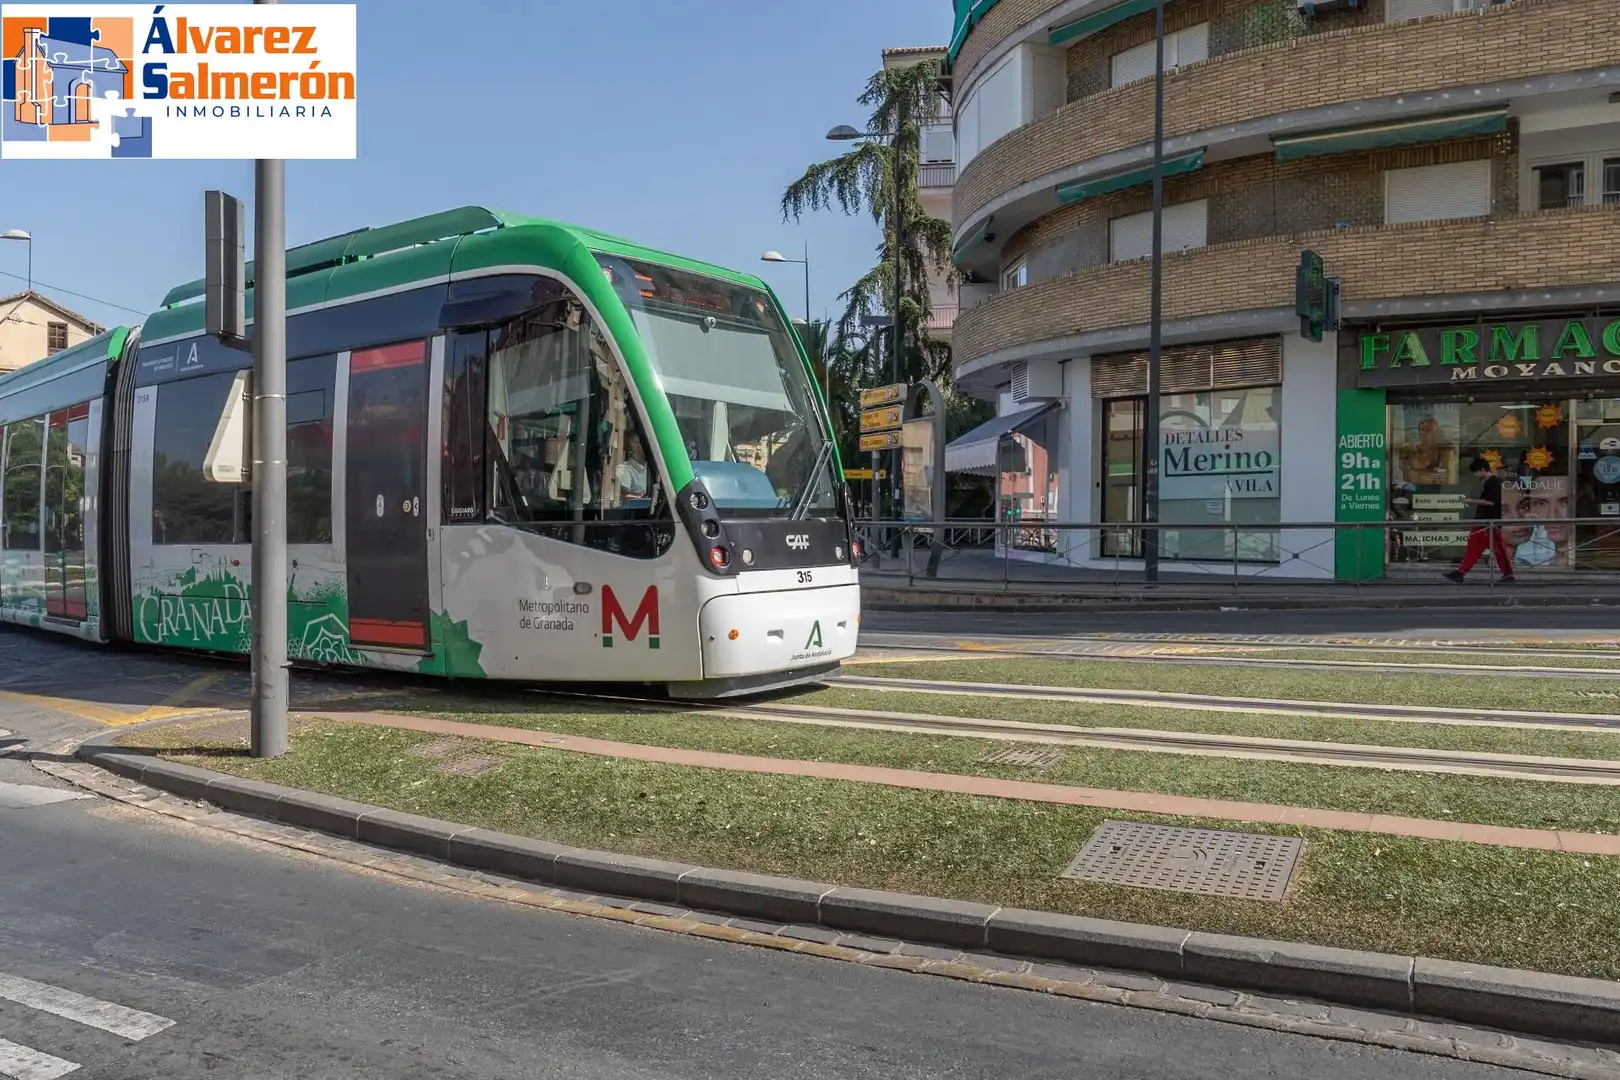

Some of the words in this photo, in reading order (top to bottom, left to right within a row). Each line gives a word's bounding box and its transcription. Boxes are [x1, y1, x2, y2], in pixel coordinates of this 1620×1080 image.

[1165, 429, 1244, 445] DETALLES
[1339, 433, 1384, 448] ABIERTO
[1165, 444, 1273, 473] Merino
[1341, 452, 1370, 469] 9h
[1371, 459, 1381, 469] a
[1341, 473, 1381, 490] 21h
[1341, 493, 1353, 502] De
[1355, 493, 1380, 502] Lunes
[1349, 501, 1380, 511] Viernes
[785, 534, 810, 550] CAF
[796, 570, 813, 584] 315
[518, 599, 590, 616] Metropolitano
[518, 615, 532, 629] de
[533, 616, 574, 631] Granada
[601, 584, 660, 649] M
